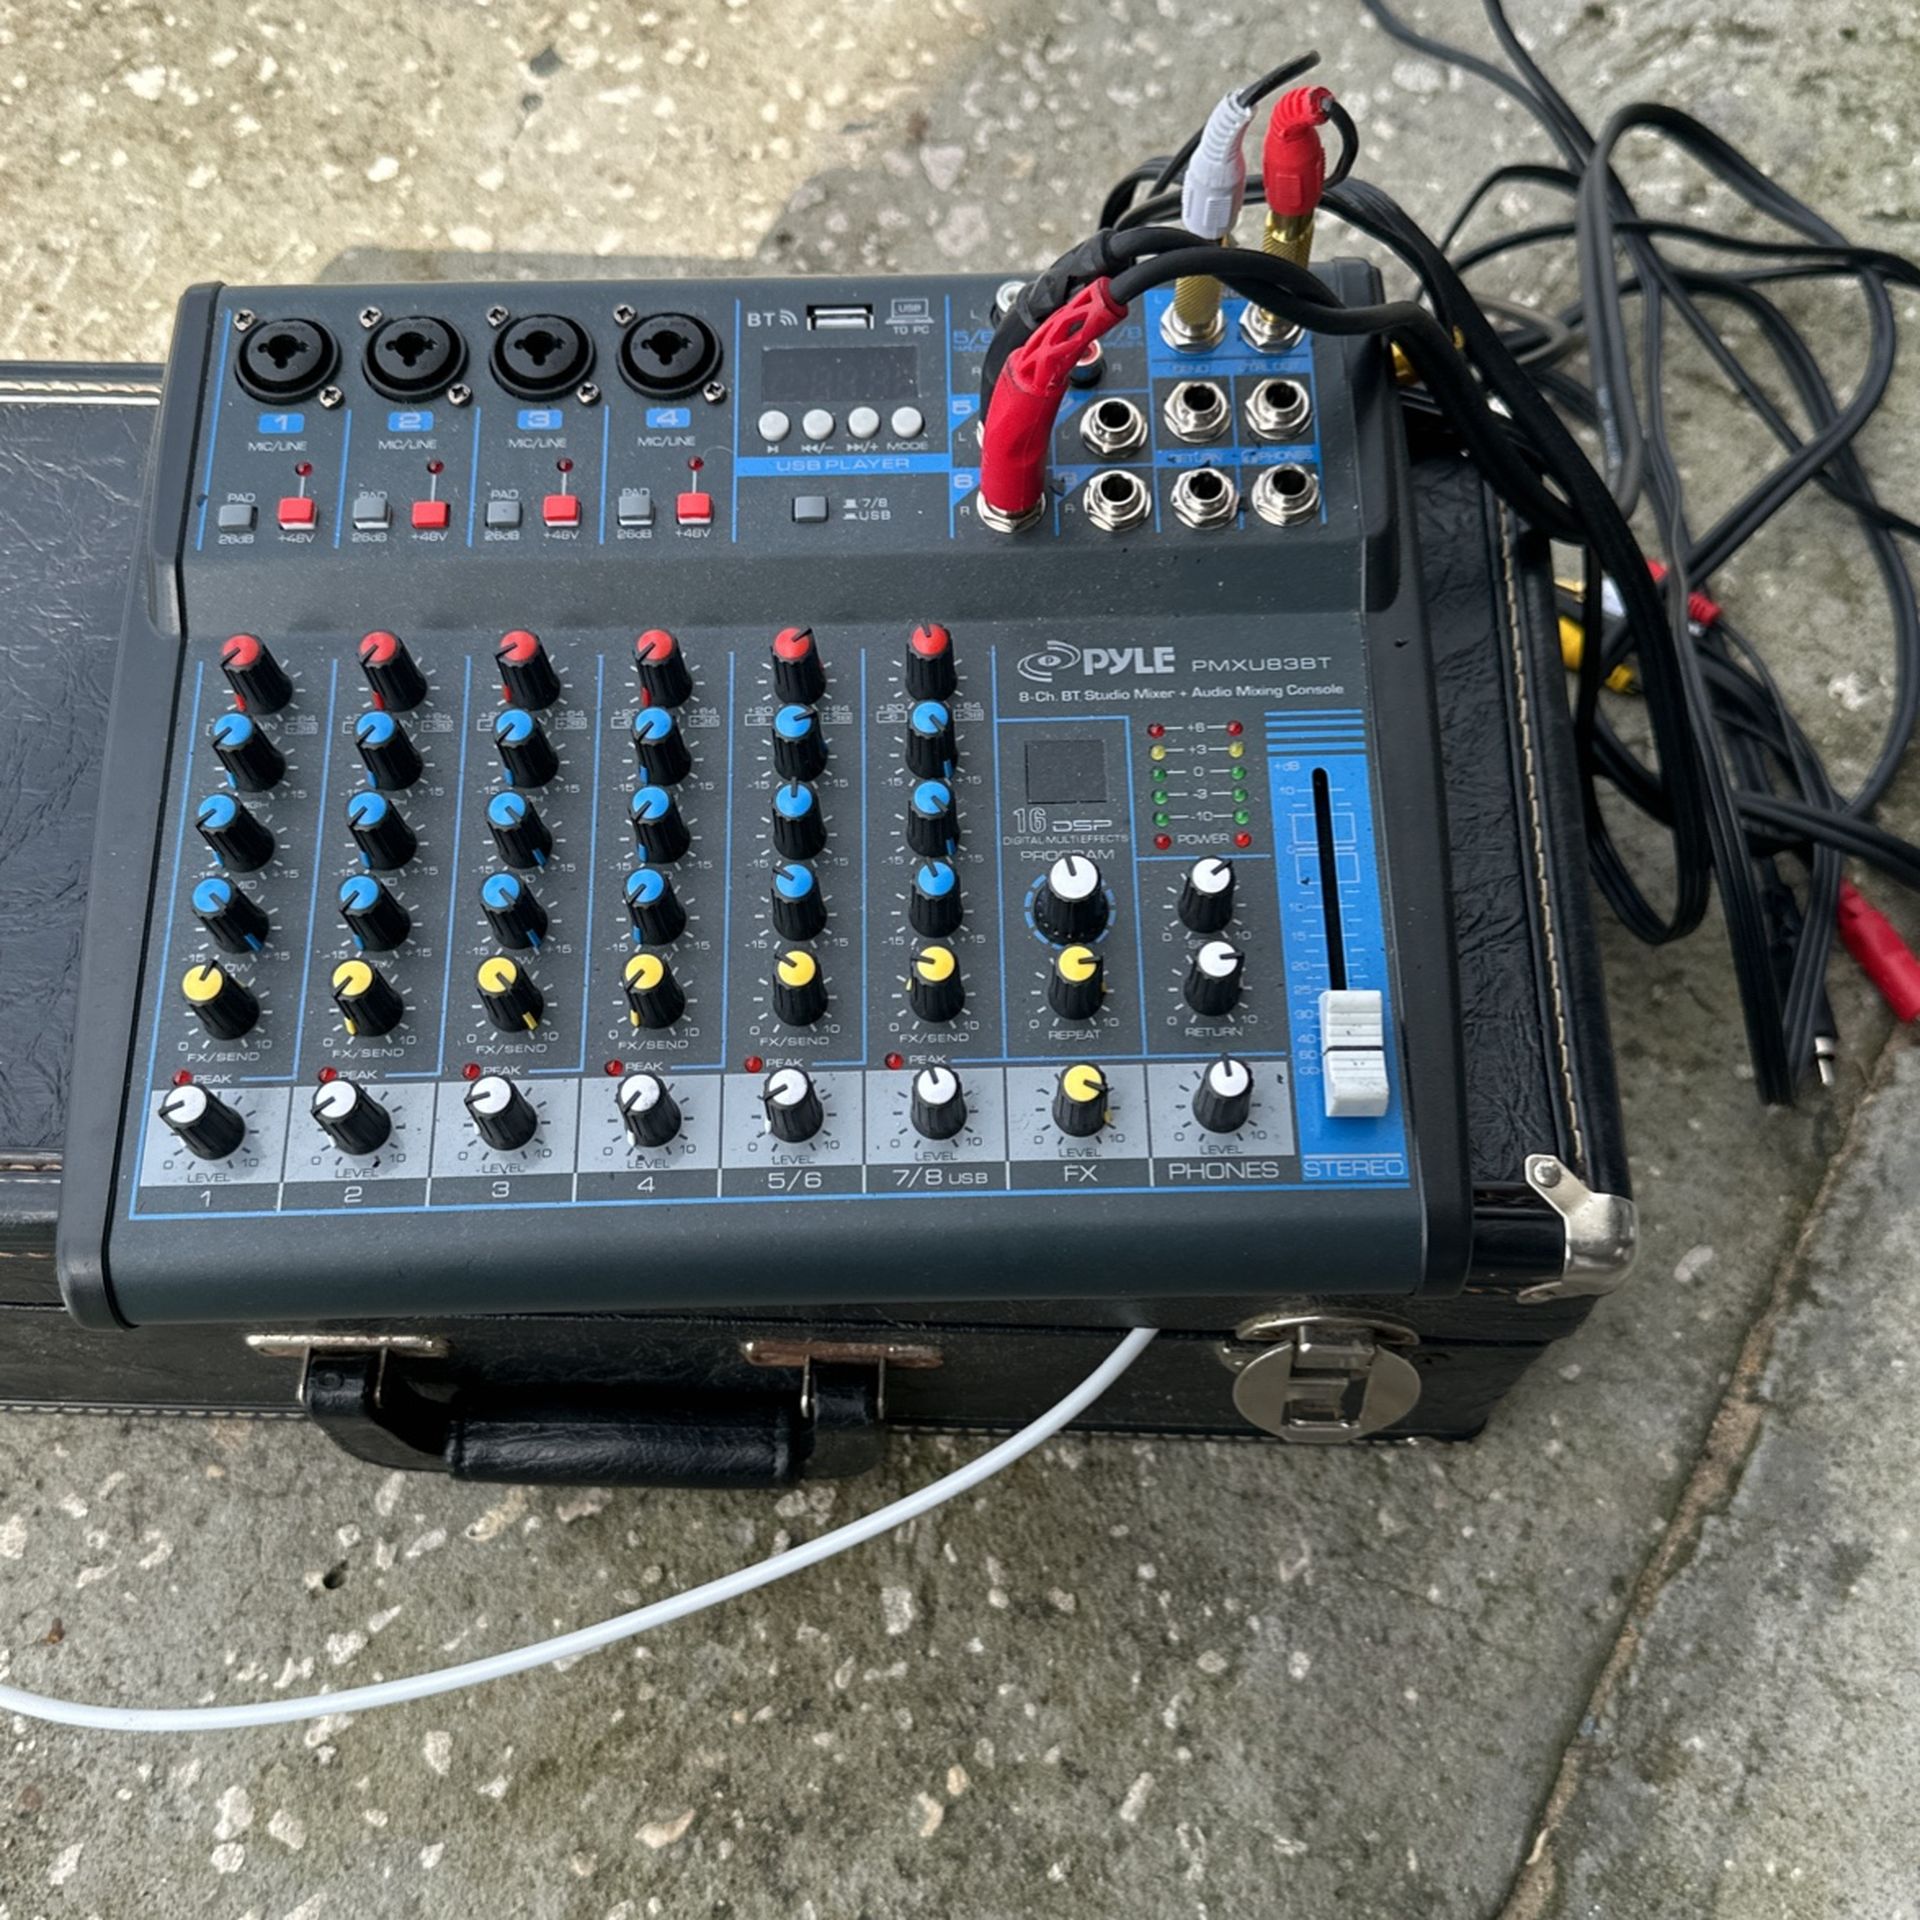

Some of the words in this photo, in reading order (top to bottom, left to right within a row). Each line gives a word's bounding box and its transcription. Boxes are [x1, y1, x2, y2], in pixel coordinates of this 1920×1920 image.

[899, 304, 921, 312] USB
[747, 312, 775, 327] BT
[893, 326, 908, 334] TO
[913, 326, 930, 334] PC
[274, 415, 287, 430] 1
[399, 414, 421, 429] 2
[527, 412, 550, 427] 3
[657, 410, 678, 425] 4
[248, 441, 308, 452] MIC/LINE
[378, 439, 438, 450] MIC/LINE
[508, 438, 567, 449] MIC/LINE
[637, 436, 696, 447] MIC/LINE
[887, 442, 928, 451] MODE
[776, 461, 822, 471] USB
[825, 459, 909, 469] PLAYER
[227, 493, 256, 503] PAD
[491, 490, 519, 499] PAD
[862, 499, 888, 508] 7/8
[859, 511, 891, 520] USB
[960, 507, 969, 515] R
[411, 532, 449, 542] +48V
[544, 531, 580, 541] +48V
[675, 529, 712, 538] +48V
[278, 534, 316, 544] +48V
[1083, 646, 1176, 675] PYLE
[1192, 657, 1332, 672] PMXU83BT
[1061, 691, 1080, 702] BT
[1084, 689, 1130, 701] Studio
[1134, 688, 1175, 700] Mixer
[1191, 686, 1232, 698] Audio
[1236, 685, 1283, 700] Mixing
[1286, 683, 1344, 696] Console
[1189, 746, 1207, 754] +3
[1193, 789, 1208, 799] -3
[1013, 808, 1048, 833] 16
[1052, 819, 1112, 832] DSP
[1190, 811, 1213, 821] -10
[1002, 835, 1043, 845] DIGITAL
[1044, 835, 1078, 844] MULTI
[1080, 833, 1129, 844] EFFECTS
[1177, 833, 1229, 845] POWER
[1236, 931, 1252, 940] 10
[1103, 1018, 1119, 1027] 10
[1241, 1015, 1257, 1024] 10
[824, 1025, 840, 1034] 10
[963, 1021, 980, 1030] 10
[542, 1031, 559, 1041] 10
[683, 1028, 700, 1037] 10
[1049, 1030, 1101, 1040] REPEAT
[1185, 1027, 1243, 1036] RETURN
[400, 1036, 417, 1045] 10
[760, 1037, 829, 1046] FX/SEND
[900, 1033, 969, 1043] FX/SEND
[256, 1039, 272, 1049] 10
[476, 1044, 547, 1053] FX/SEND
[618, 1040, 688, 1050] FX/SEND
[187, 1052, 260, 1062] FX/SEND
[332, 1048, 404, 1058] FX/SEND
[766, 1058, 804, 1068] PEAK
[908, 1056, 946, 1064] PEAK
[482, 1066, 521, 1075] PEAK
[625, 1062, 663, 1071] PEAK
[192, 1074, 232, 1084] PEAK
[338, 1070, 378, 1080] PEAK
[1109, 1134, 1125, 1143] 10
[1251, 1131, 1267, 1140] 10
[824, 1141, 840, 1150] 10
[966, 1137, 982, 1146] 10
[535, 1150, 552, 1158] 10
[680, 1145, 696, 1154] 10
[1059, 1148, 1102, 1157] LEVEL
[1199, 1145, 1243, 1154] LEVEL
[390, 1154, 406, 1162] 10
[772, 1156, 814, 1164] LEVEL
[915, 1152, 958, 1162] LEVEL
[242, 1158, 258, 1167] 10
[628, 1160, 670, 1168] LEVEL
[335, 1169, 379, 1178] LEVEL
[482, 1164, 525, 1173] LEVEL
[1064, 1164, 1098, 1182] FX
[1168, 1161, 1279, 1179] PHONES
[1304, 1160, 1404, 1178] STEREO
[188, 1174, 230, 1182] LEVEL
[768, 1171, 822, 1191] 5/6
[892, 1167, 942, 1188] 7/8
[949, 1173, 988, 1184] USB
[637, 1176, 655, 1192] 4
[344, 1186, 362, 1203] 2
[492, 1182, 510, 1198] 3
[200, 1190, 212, 1207] 1
